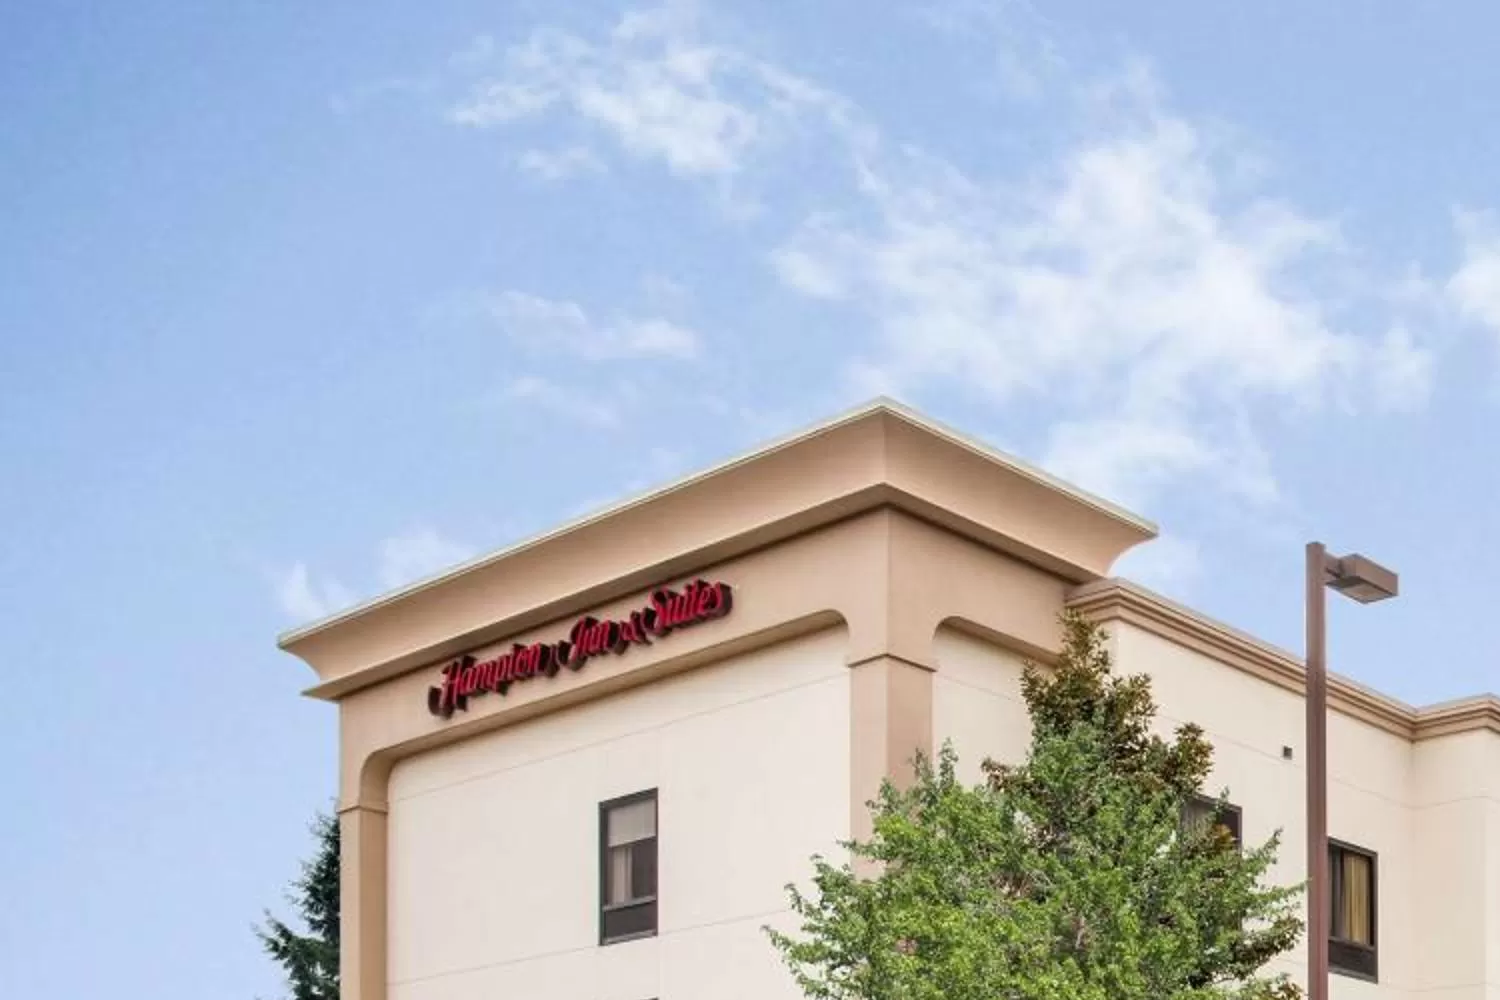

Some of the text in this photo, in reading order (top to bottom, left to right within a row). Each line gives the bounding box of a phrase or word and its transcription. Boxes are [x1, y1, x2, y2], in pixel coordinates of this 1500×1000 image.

[428, 641, 556, 720] Hampton
[560, 615, 630, 672] Inn
[646, 576, 733, 638] Suites
